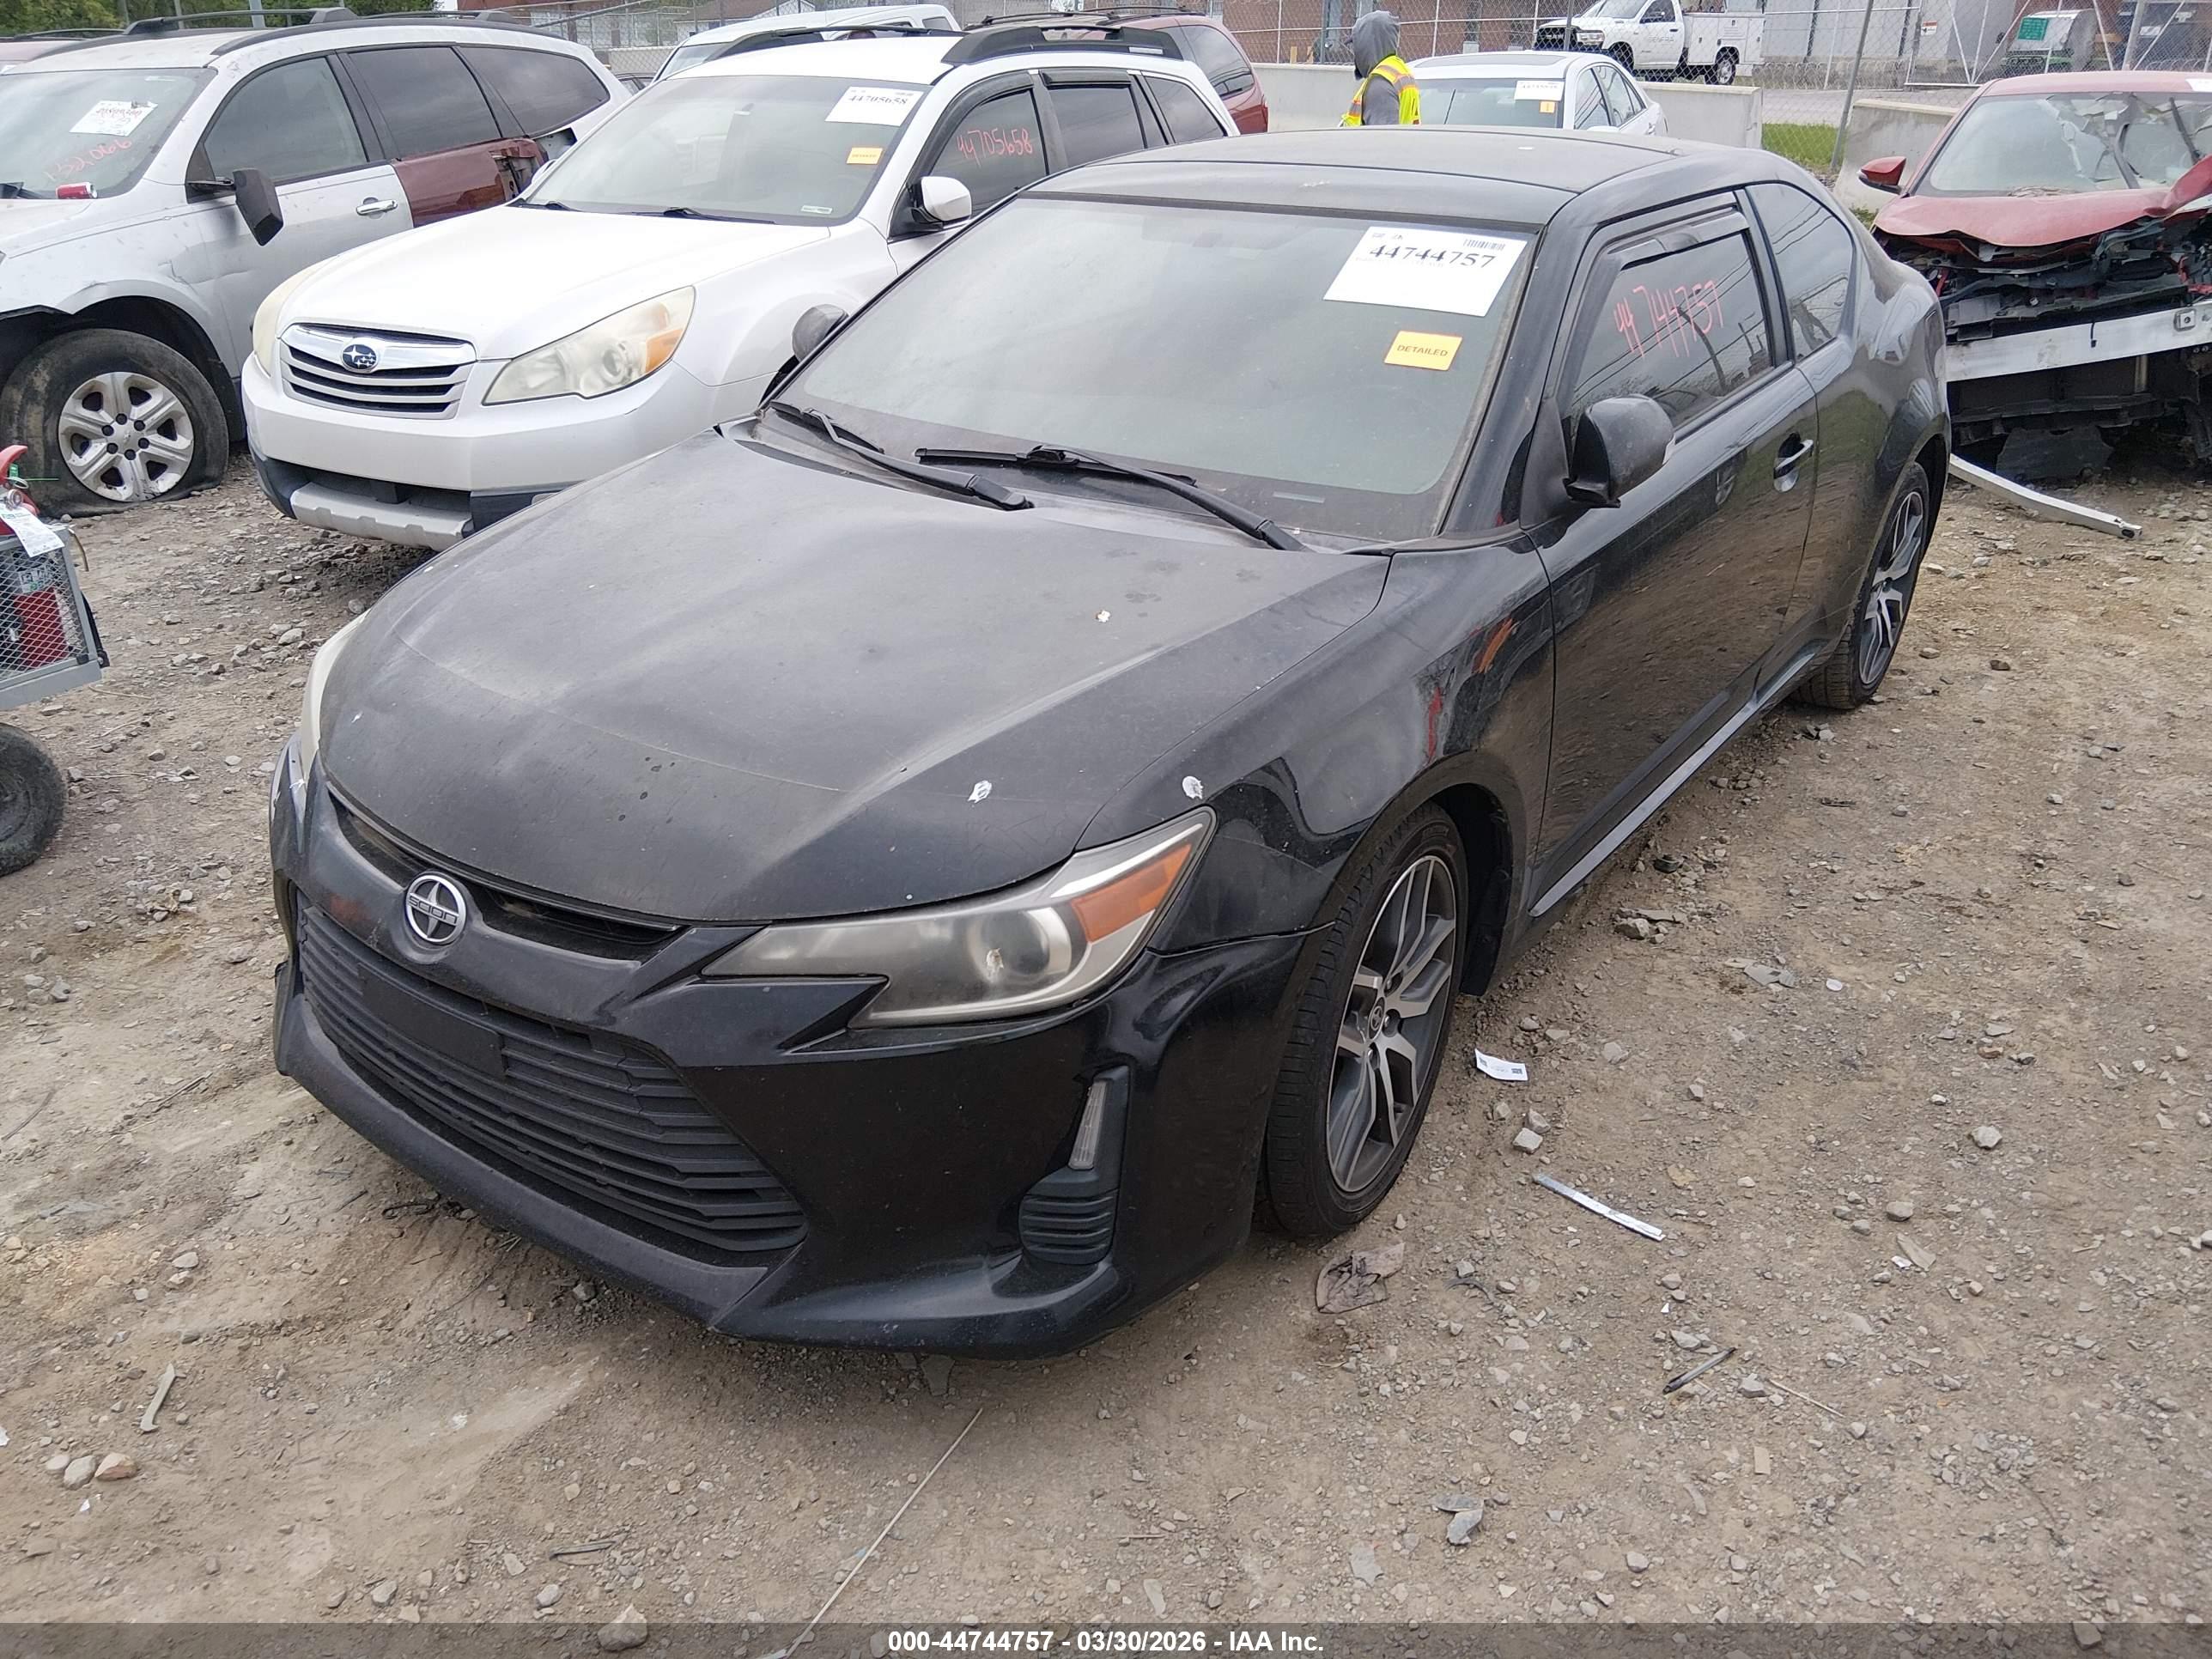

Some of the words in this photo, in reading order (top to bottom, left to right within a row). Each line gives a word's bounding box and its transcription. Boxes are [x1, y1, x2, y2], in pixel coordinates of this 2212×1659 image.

[957, 128, 1033, 167] 44705658
[1369, 244, 1497, 269] 44744757
[1396, 343, 1449, 358] DETAILED
[409, 895, 458, 924] SCION
